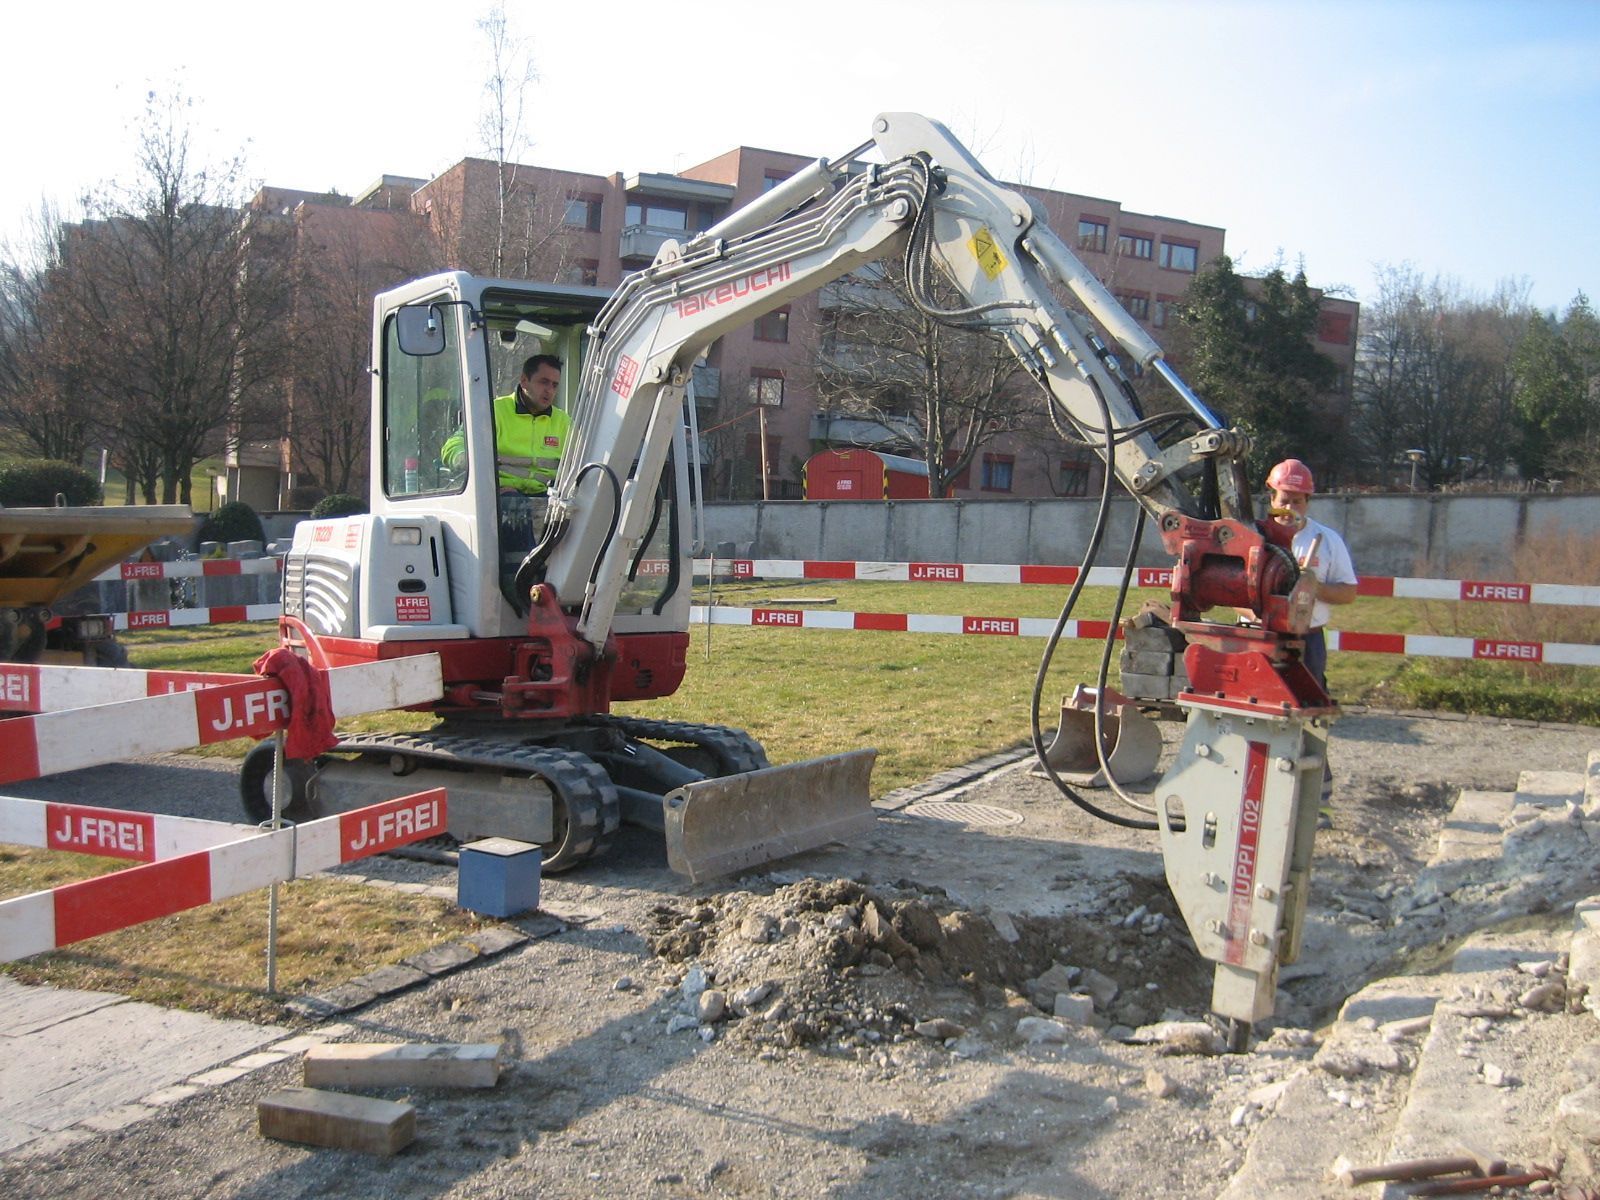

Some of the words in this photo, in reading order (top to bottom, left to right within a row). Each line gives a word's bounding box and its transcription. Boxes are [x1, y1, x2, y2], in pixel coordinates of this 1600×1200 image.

[124, 565, 160, 577] J.FREI
[735, 563, 749, 574] EI
[914, 567, 959, 578] J.FREI
[1466, 585, 1523, 599] J.FREI
[397, 598, 428, 607] J.FREI
[131, 613, 166, 625] J.FREI
[757, 612, 799, 624] J.FREI
[968, 620, 1015, 632] J.FREI
[1479, 643, 1537, 658] J.FREI
[1243, 799, 1260, 833] 102
[351, 800, 438, 850] J.FREI
[56, 815, 144, 852] J.FREI
